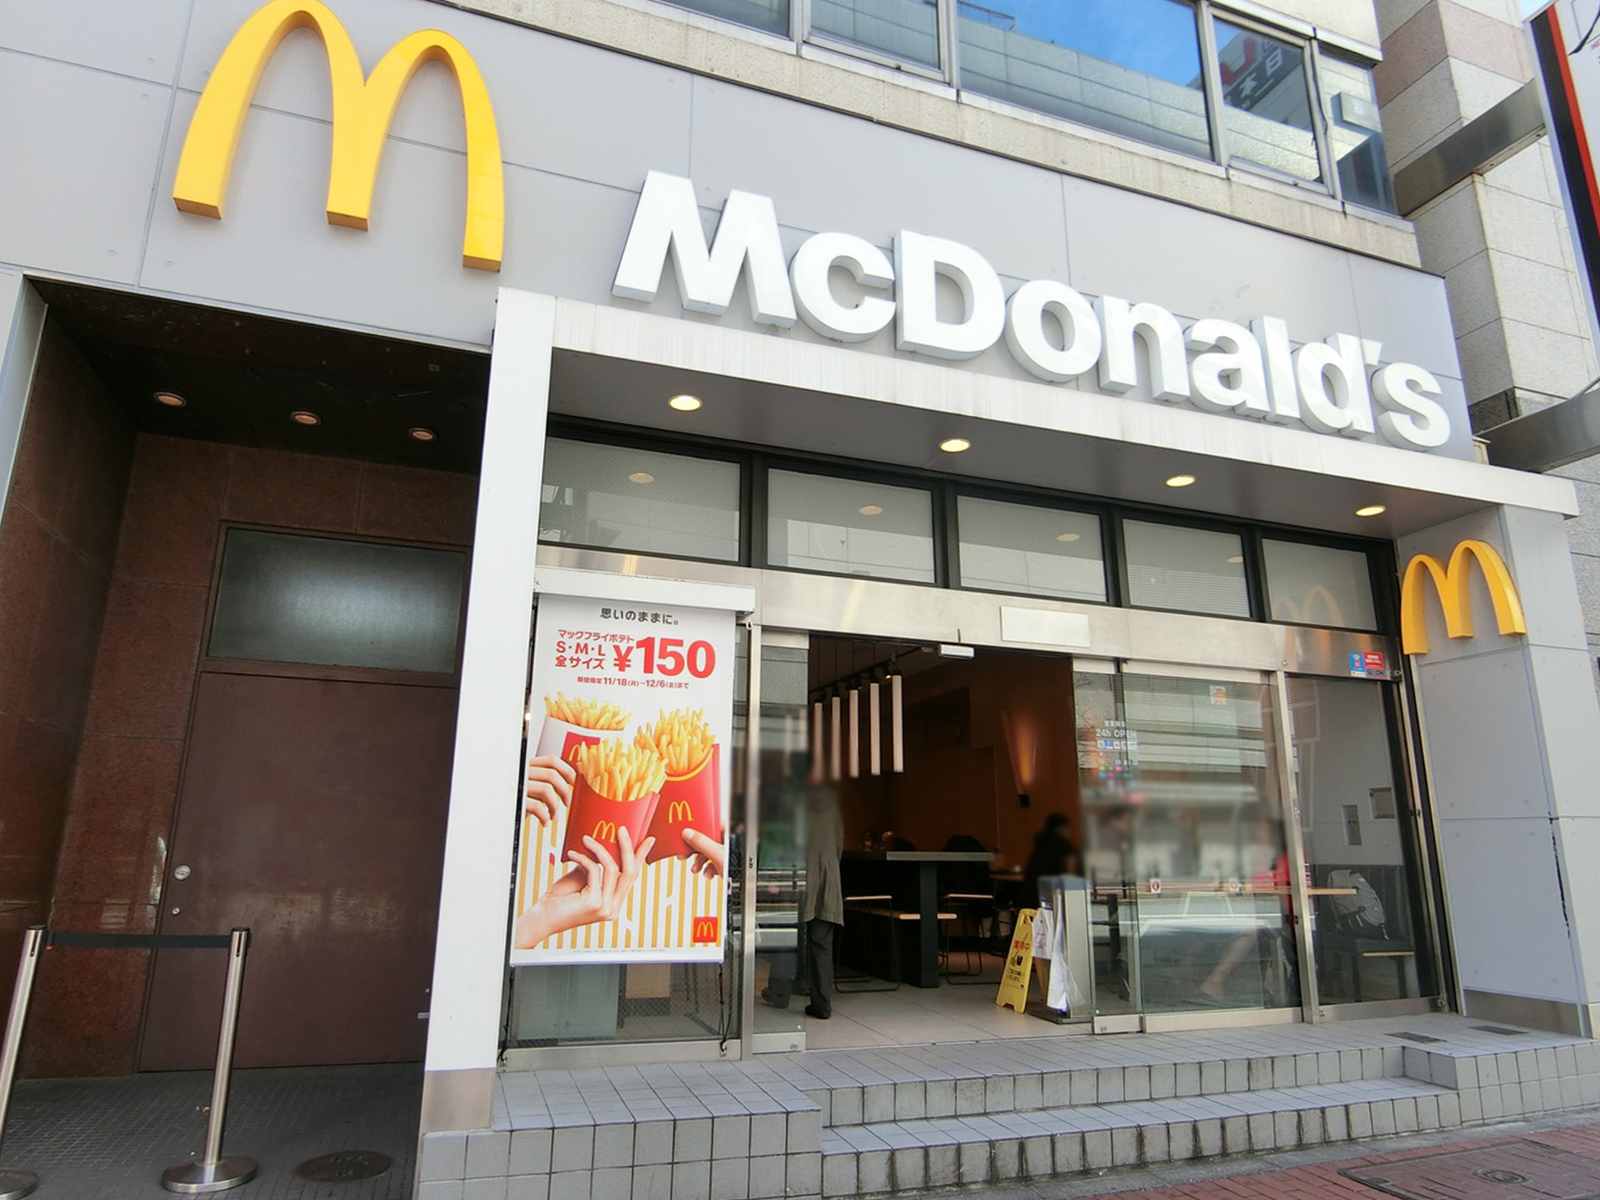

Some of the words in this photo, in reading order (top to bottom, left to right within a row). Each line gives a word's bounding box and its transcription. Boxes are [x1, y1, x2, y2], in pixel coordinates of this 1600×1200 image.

[611, 170, 1451, 451] McDonald's
[600, 608, 679, 625] 思いのままに。
[557, 629, 635, 644] マックフライポテト
[555, 655, 606, 670] 全サイズ
[612, 636, 716, 679] ¥150
[1114, 729, 1137, 738] OPEN
